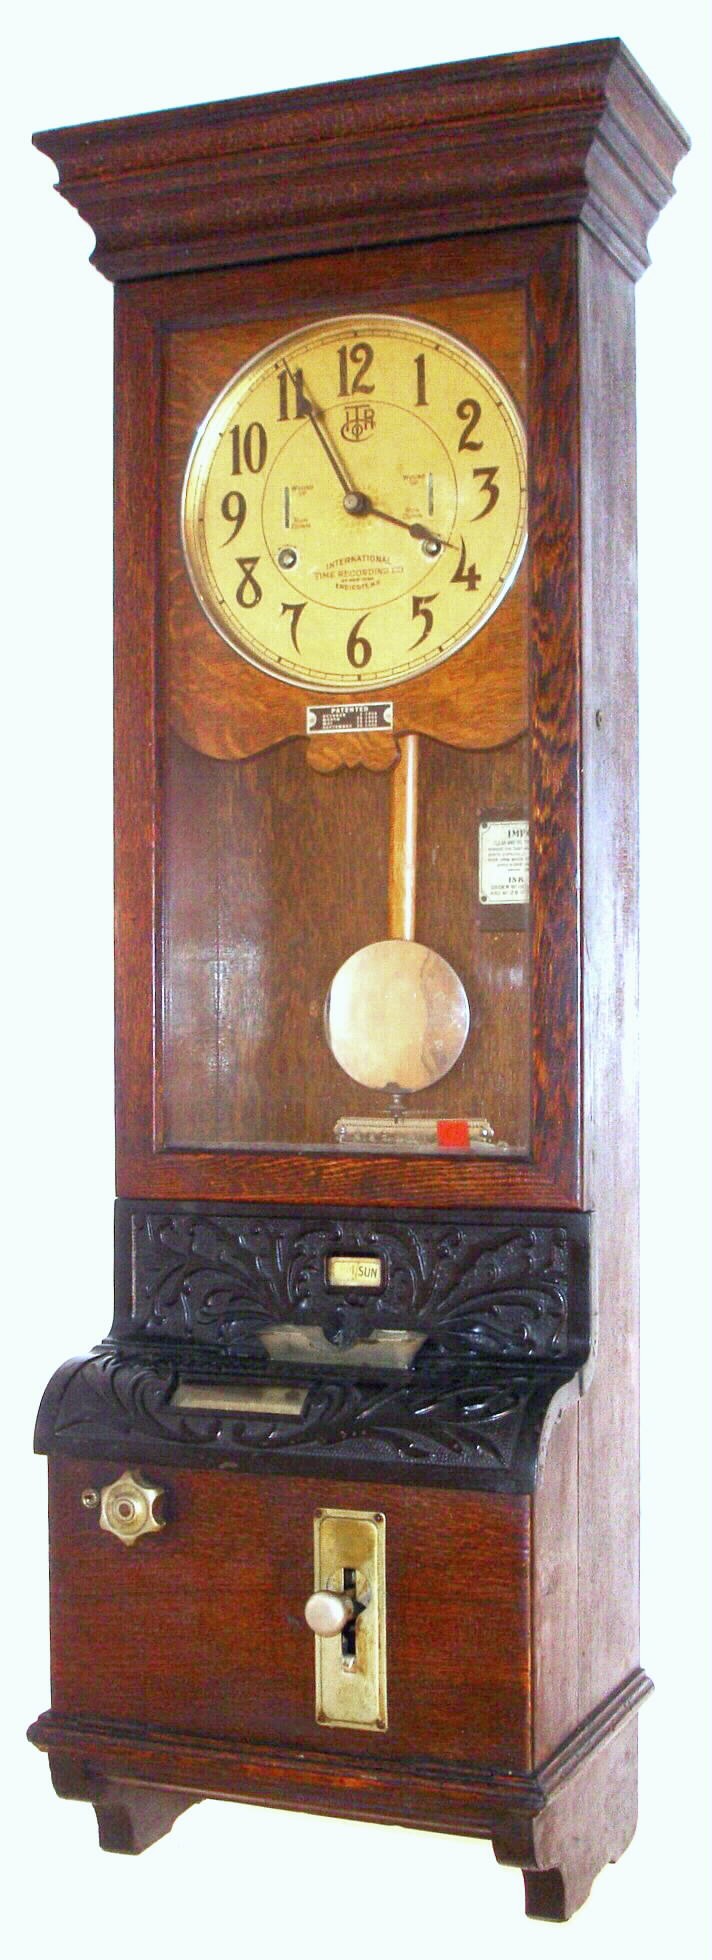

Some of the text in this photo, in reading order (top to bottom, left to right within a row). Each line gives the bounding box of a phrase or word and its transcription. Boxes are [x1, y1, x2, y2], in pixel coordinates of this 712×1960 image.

[277, 367, 308, 422] 11
[337, 342, 375, 397] 12
[413, 353, 429, 407] 1
[229, 422, 267, 476] 10
[456, 398, 484, 453] 2
[220, 491, 246, 548] 9
[470, 466, 500, 522] 3
[235, 556, 262, 608] 8
[313, 571, 335, 580] TIME
[337, 567, 389, 577] RECORDING
[326, 554, 392, 569] INTERNATIONAL
[450, 535, 481, 591] 4
[281, 602, 308, 655] 7
[347, 612, 372, 668] 6
[408, 593, 440, 651] 5
[358, 1266, 377, 1278] SUN
